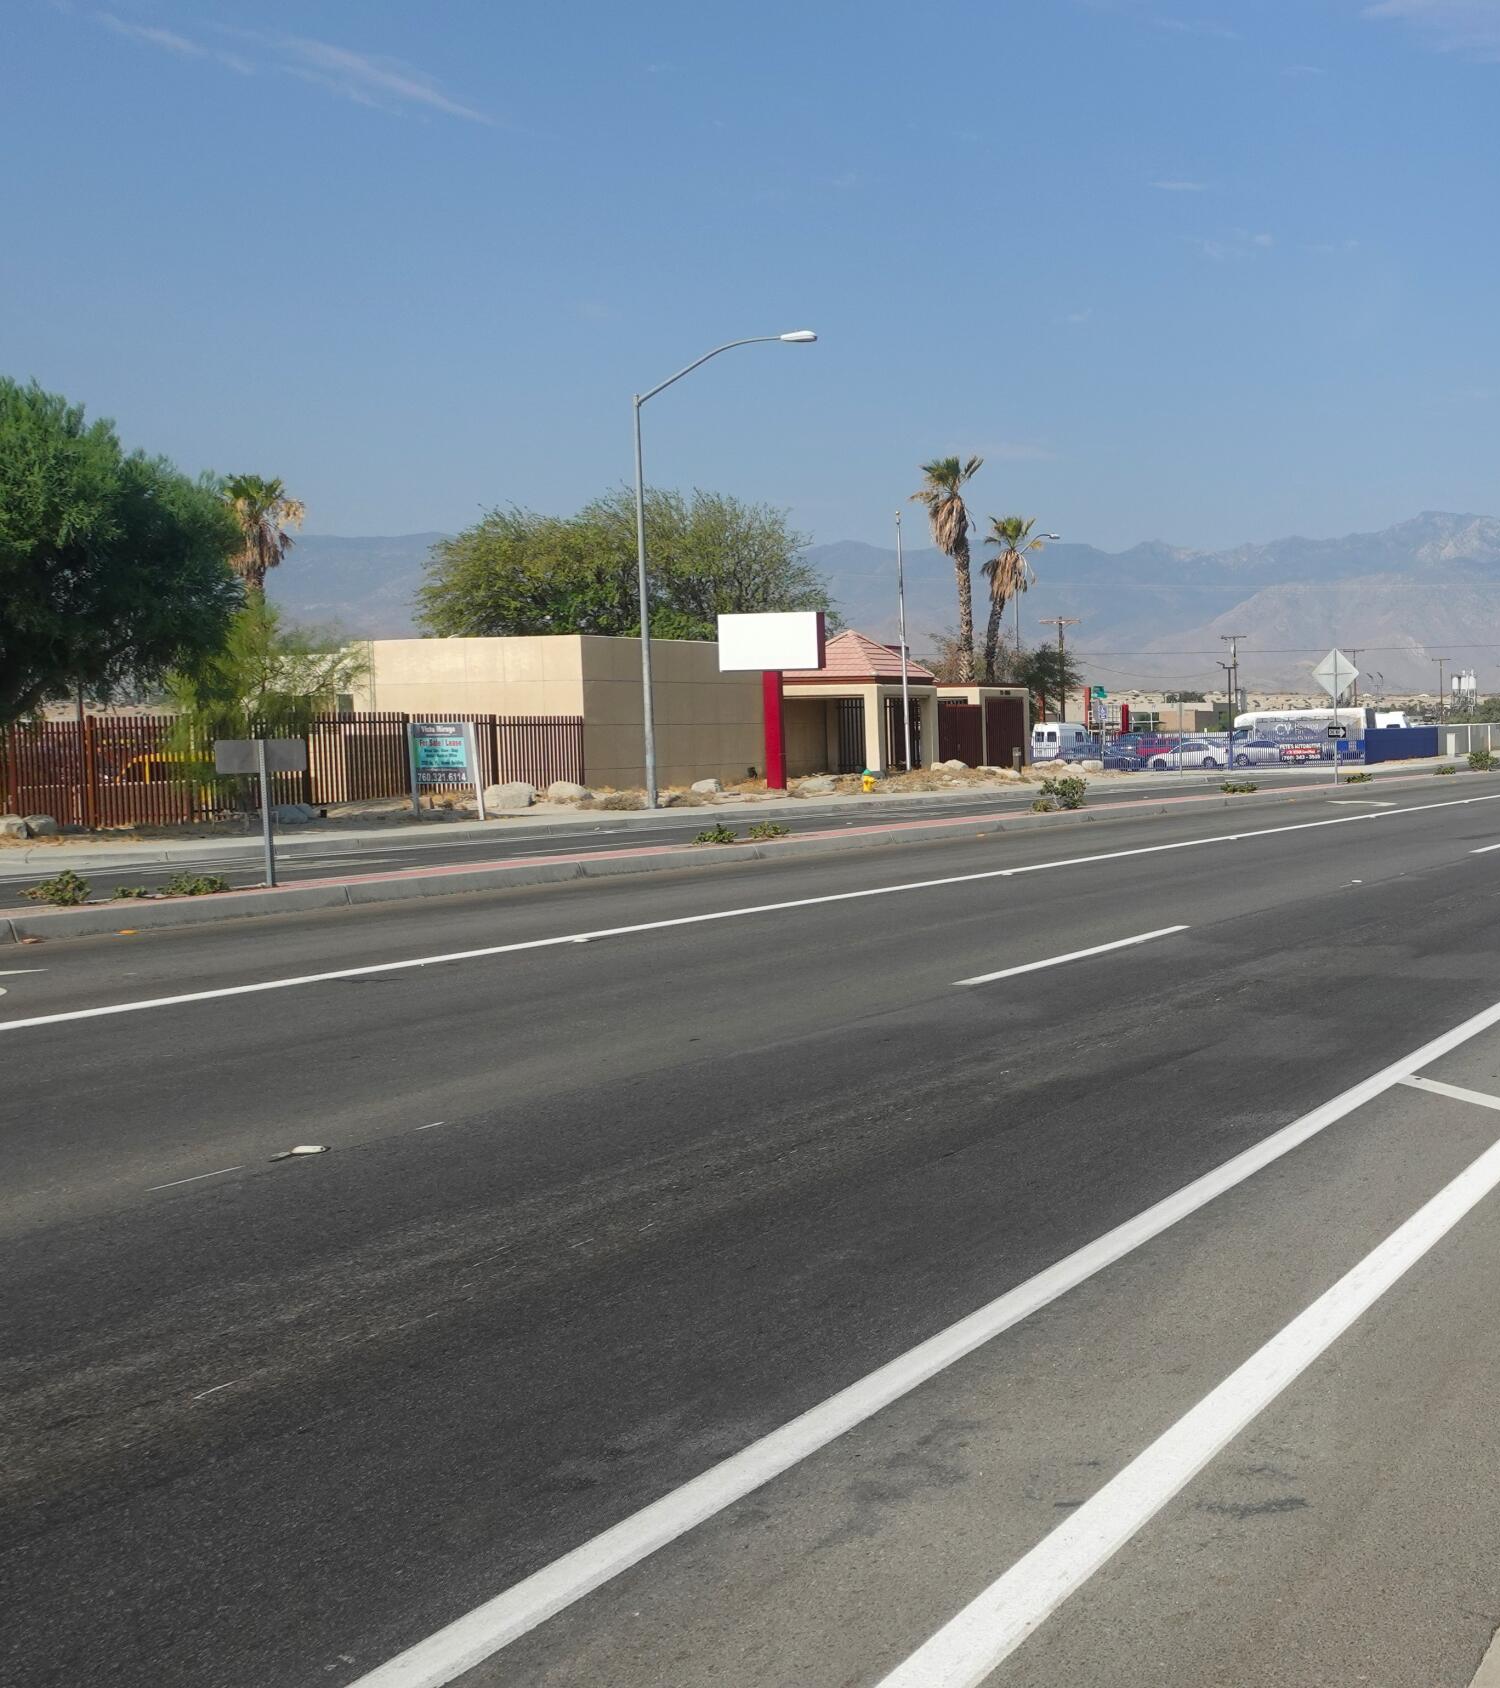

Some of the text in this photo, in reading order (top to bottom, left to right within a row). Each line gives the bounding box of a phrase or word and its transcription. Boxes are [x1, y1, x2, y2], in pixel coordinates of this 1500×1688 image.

[419, 739, 428, 747] For
[429, 739, 441, 747] Sale
[445, 739, 462, 747] Lease
